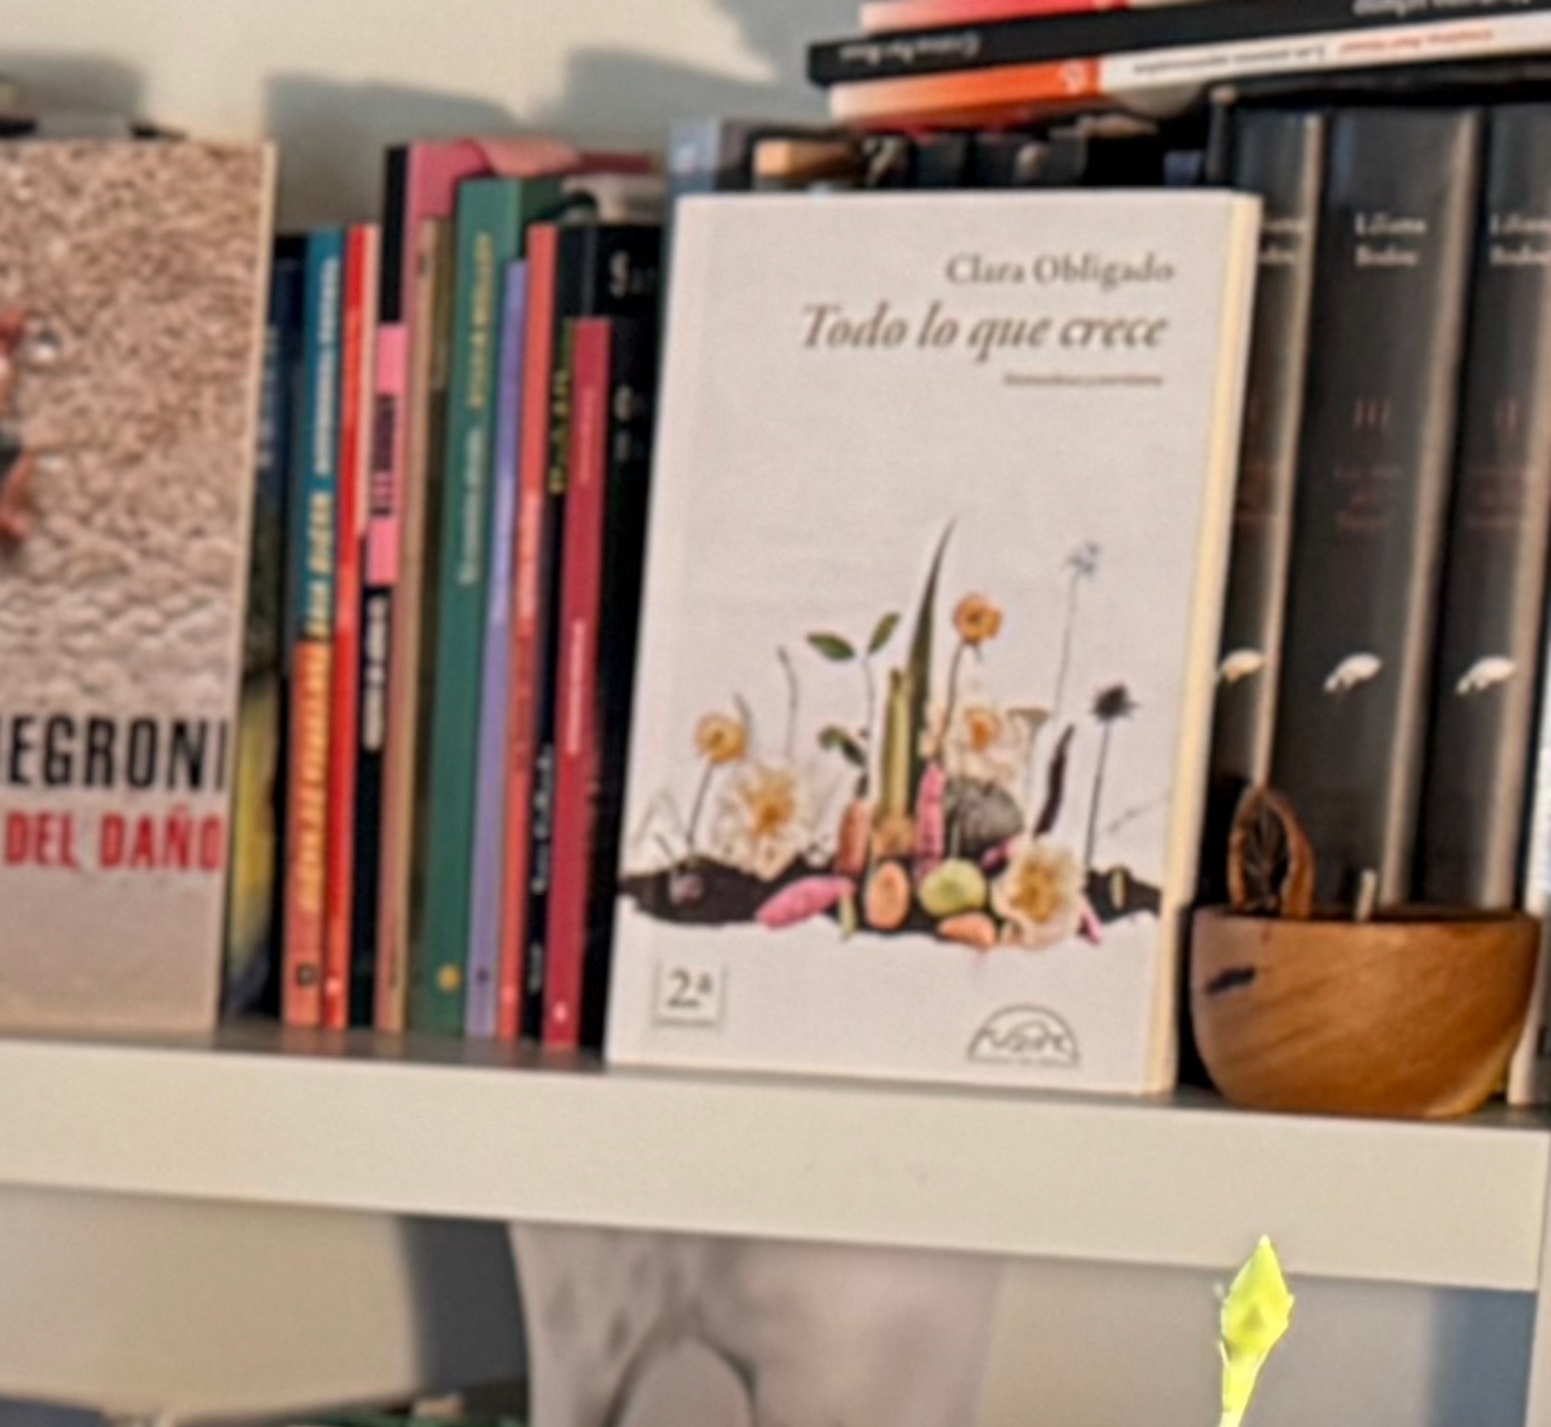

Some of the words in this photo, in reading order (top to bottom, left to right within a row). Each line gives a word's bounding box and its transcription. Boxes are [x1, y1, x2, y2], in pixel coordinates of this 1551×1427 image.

[945, 253, 1027, 285] Clara
[1032, 251, 1176, 292] Obligado
[801, 300, 908, 349] Todo
[916, 299, 959, 349] lo
[966, 315, 1050, 365] que
[1059, 316, 1169, 349] crece
[5, 810, 79, 868] DEL
[100, 801, 224, 871] DAÑO
